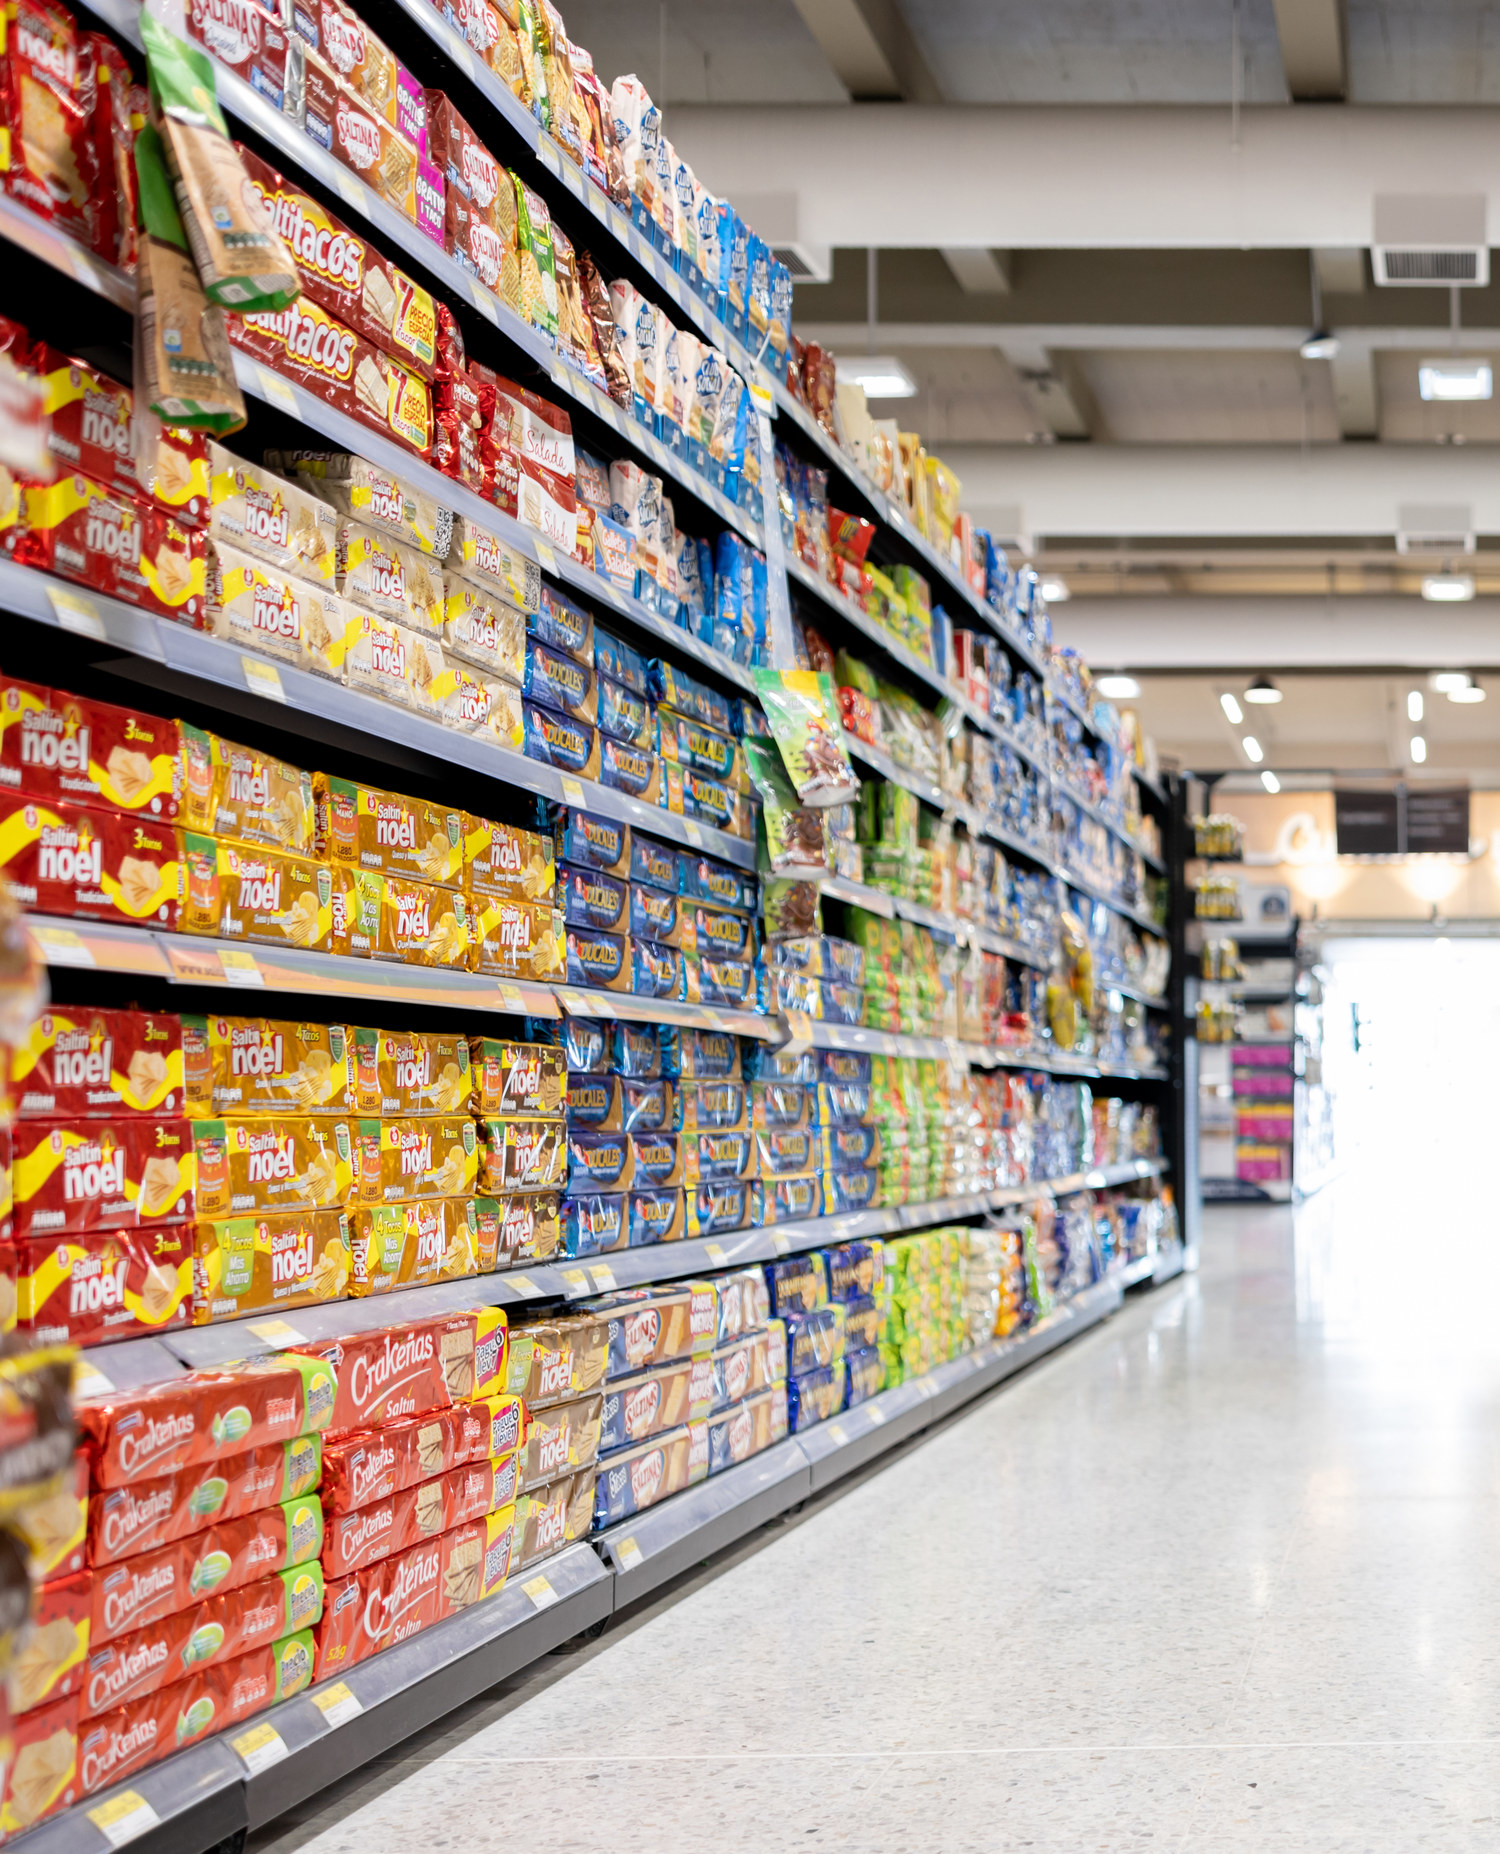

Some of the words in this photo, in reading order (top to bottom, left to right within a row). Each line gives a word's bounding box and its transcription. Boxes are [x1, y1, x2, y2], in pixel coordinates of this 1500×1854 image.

[409, 305, 434, 331] PRECIO
[526, 430, 567, 470] Salada
[370, 490, 404, 523] noel
[245, 507, 289, 547] noel
[371, 565, 406, 601] noel
[253, 599, 300, 639] noel
[372, 642, 406, 679] noel
[546, 660, 584, 693] DUCALES
[125, 718, 136, 741] 3
[546, 722, 585, 755] DUCALES
[22, 726, 90, 771] noel
[617, 749, 648, 776] DUCALES
[377, 801, 402, 820] Saltín
[695, 778, 728, 811] DUCALES
[376, 813, 416, 849] noel
[423, 808, 429, 822] 4
[134, 827, 143, 849] 3
[587, 823, 618, 851] DUCALES
[39, 838, 102, 884] noel
[290, 864, 296, 879] 4
[238, 872, 281, 912] noel
[586, 885, 620, 911] DUCALES
[709, 915, 741, 942] DUCALES
[580, 942, 619, 966] DUCALES
[145, 1020, 153, 1042] 3
[231, 1026, 262, 1045] Saltín
[296, 1024, 302, 1039] 4
[54, 1038, 113, 1086] noel
[231, 1033, 284, 1077] noel
[569, 1089, 607, 1108] DUCALES
[155, 1127, 164, 1148] 3
[249, 1133, 278, 1153] Saltín
[306, 1126, 313, 1142] 4
[249, 1136, 296, 1183] noel
[587, 1147, 621, 1168] DUCALES
[640, 1146, 672, 1165] DUCALES
[64, 1149, 125, 1201] noel
[222, 1227, 231, 1251] 4
[375, 1211, 384, 1234] 4
[504, 1216, 534, 1249] noel
[153, 1234, 163, 1256] 3
[271, 1232, 297, 1253] Saltín
[271, 1235, 314, 1284] noel
[70, 1257, 131, 1316] noel
[351, 1331, 434, 1407] Crakeñas
[539, 1350, 574, 1398] noel
[491, 1413, 512, 1436] Pague
[511, 1401, 519, 1424] 6
[119, 1413, 195, 1472] Crakeñas
[539, 1432, 572, 1474] noel
[341, 1508, 393, 1561] Crakeñas
[536, 1501, 567, 1550] noel
[103, 1564, 175, 1630] Crakeñas
[363, 1552, 440, 1639] Crakeñas
[88, 1640, 169, 1709] Crakeñas
